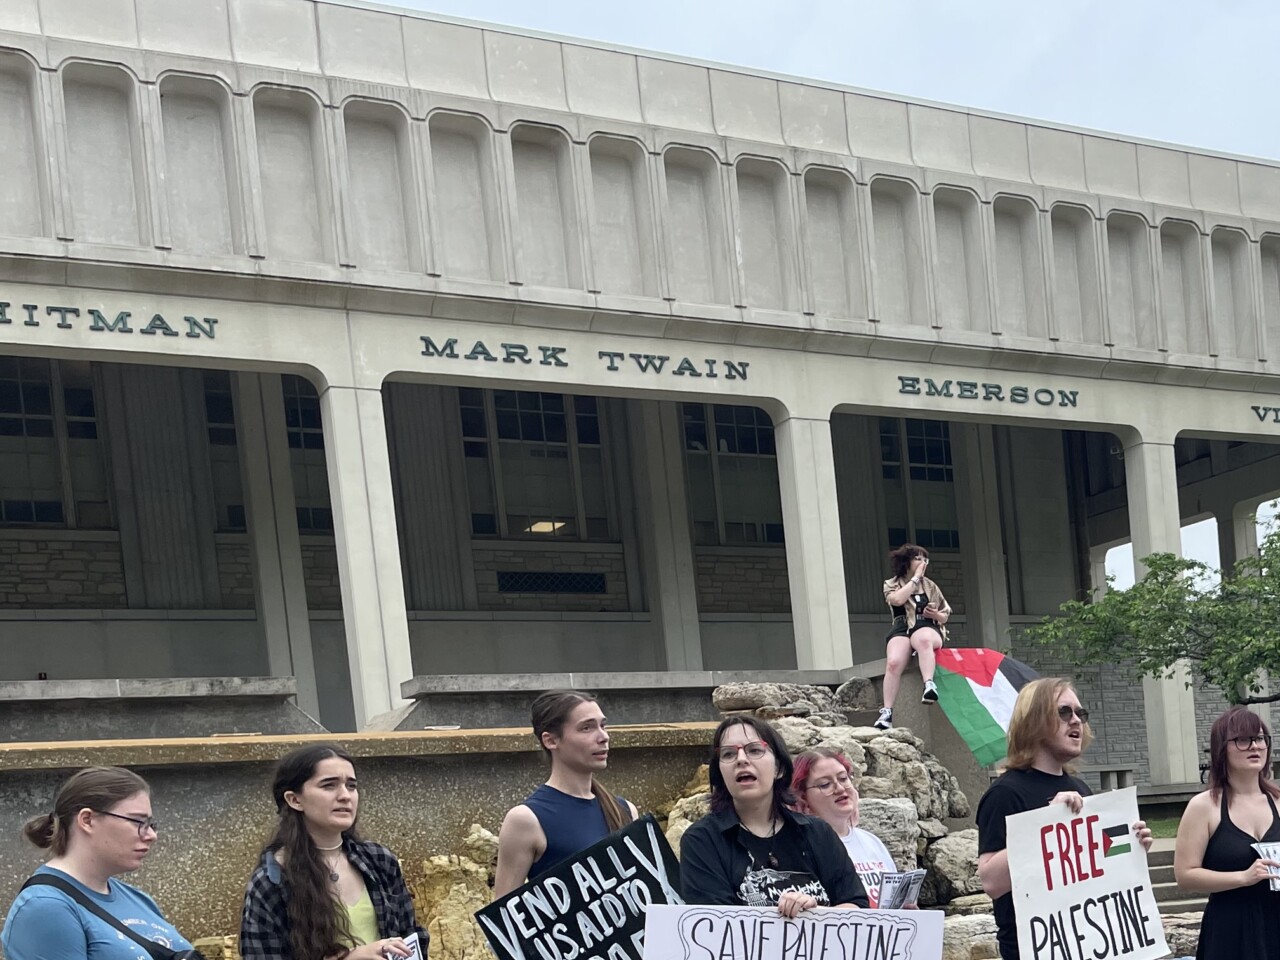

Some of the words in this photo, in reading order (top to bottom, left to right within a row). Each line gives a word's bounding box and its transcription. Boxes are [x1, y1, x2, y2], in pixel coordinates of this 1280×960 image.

[419, 335, 569, 367] MARK
[598, 351, 750, 381] TWAIN
[897, 375, 1080, 408] EMERSON
[1039, 814, 1105, 892] FREE
[506, 876, 571, 940] END
[571, 845, 637, 903] ALL
[576, 893, 627, 949] AID
[615, 878, 651, 918] TO
